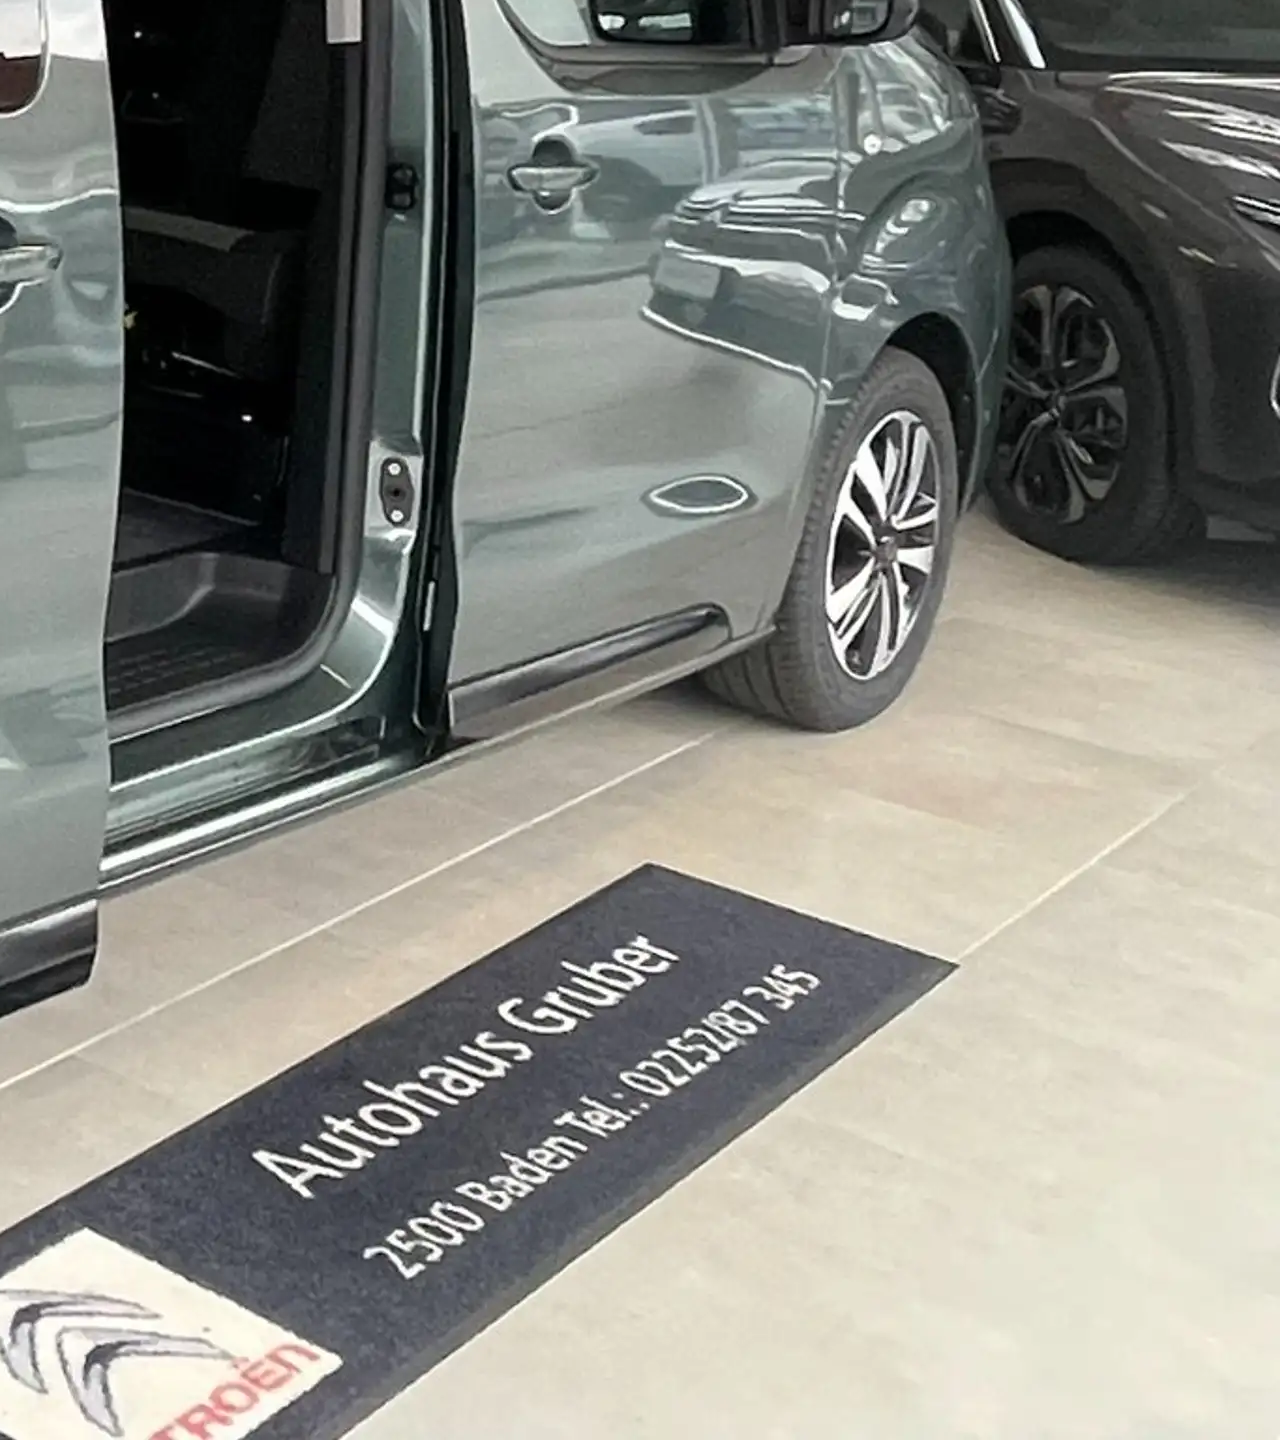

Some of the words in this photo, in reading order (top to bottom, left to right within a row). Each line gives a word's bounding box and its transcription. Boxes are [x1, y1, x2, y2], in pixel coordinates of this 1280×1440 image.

[252, 1031, 534, 1200] Autohaus
[497, 934, 680, 1035] Gruber
[363, 1200, 485, 1280] 2500
[456, 1151, 588, 1213] Baden
[619, 998, 771, 1097] 02252/87
[742, 963, 821, 1011] 345
